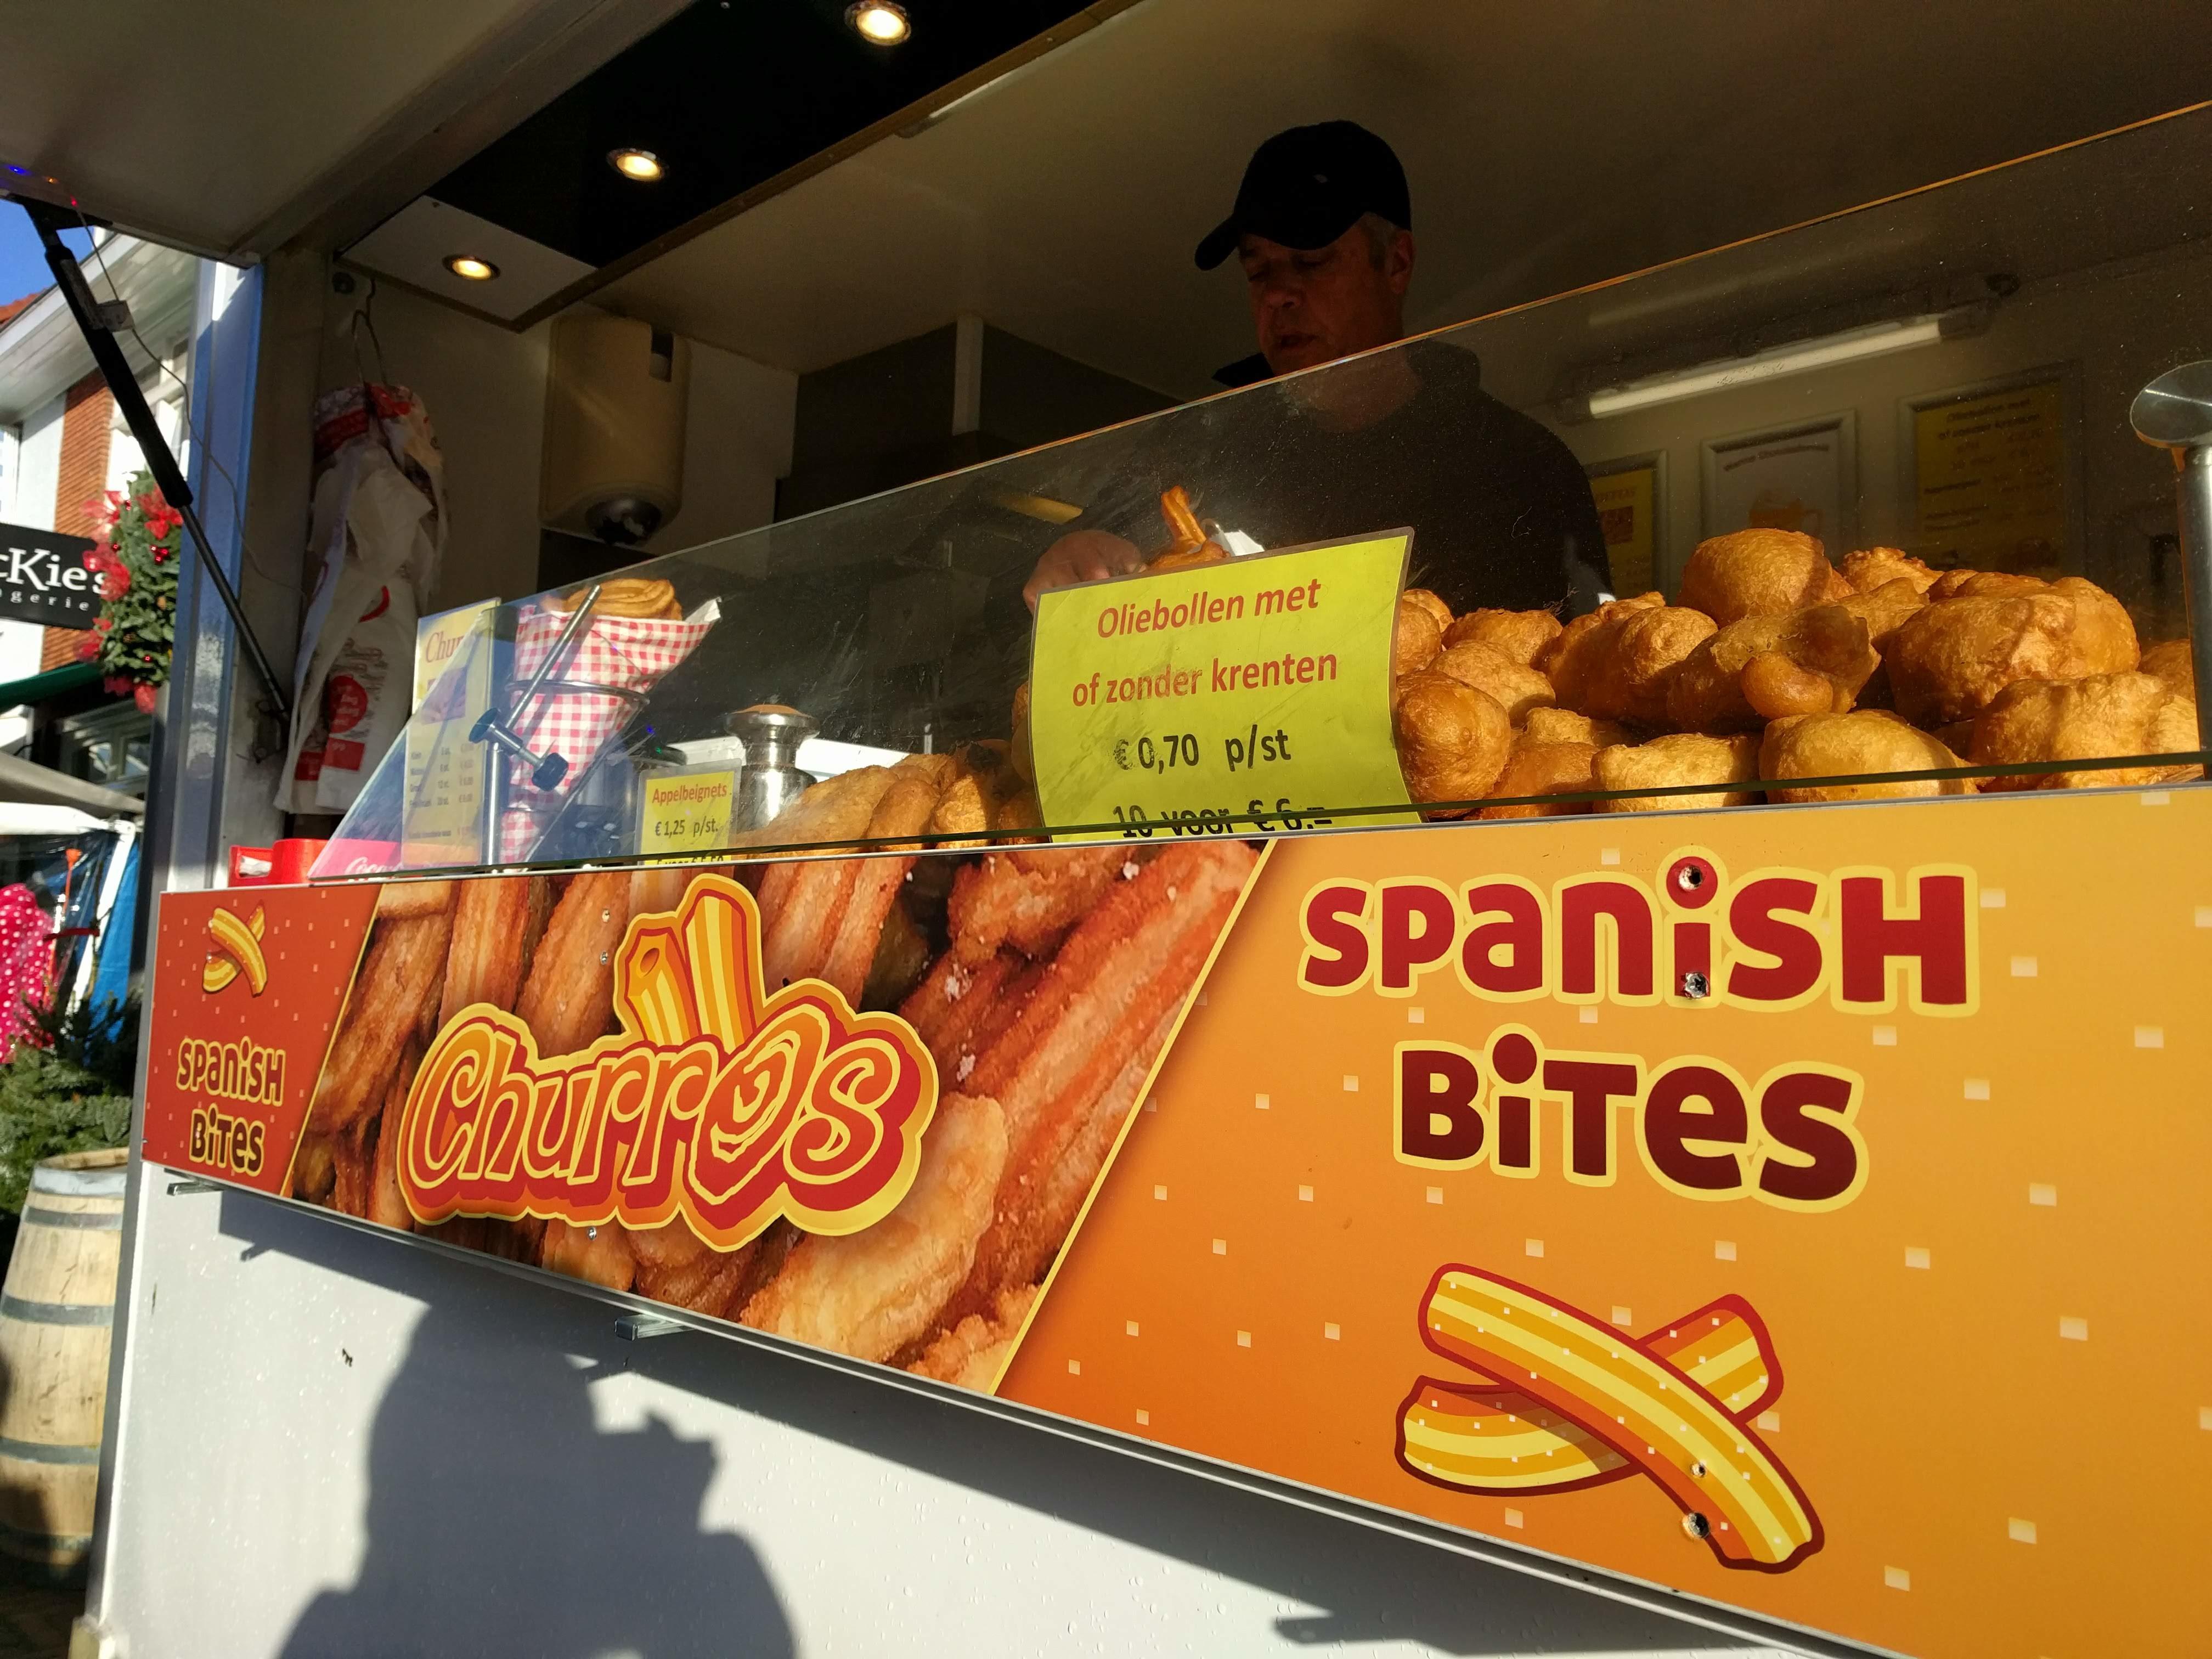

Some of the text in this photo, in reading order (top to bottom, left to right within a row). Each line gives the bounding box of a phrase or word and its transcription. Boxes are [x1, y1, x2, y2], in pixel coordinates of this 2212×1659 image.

[0, 588, 89, 612] gerie
[1098, 578, 1322, 638] Oliebollen met
[1073, 653, 1337, 707] of zonder krenten
[1224, 724, 1291, 772] p/st
[652, 782, 727, 807] Appelbeignets
[664, 820, 686, 838] 1,25
[692, 815, 719, 838] p/st.
[1113, 804, 1153, 838] 10
[1160, 808, 1234, 836] voor
